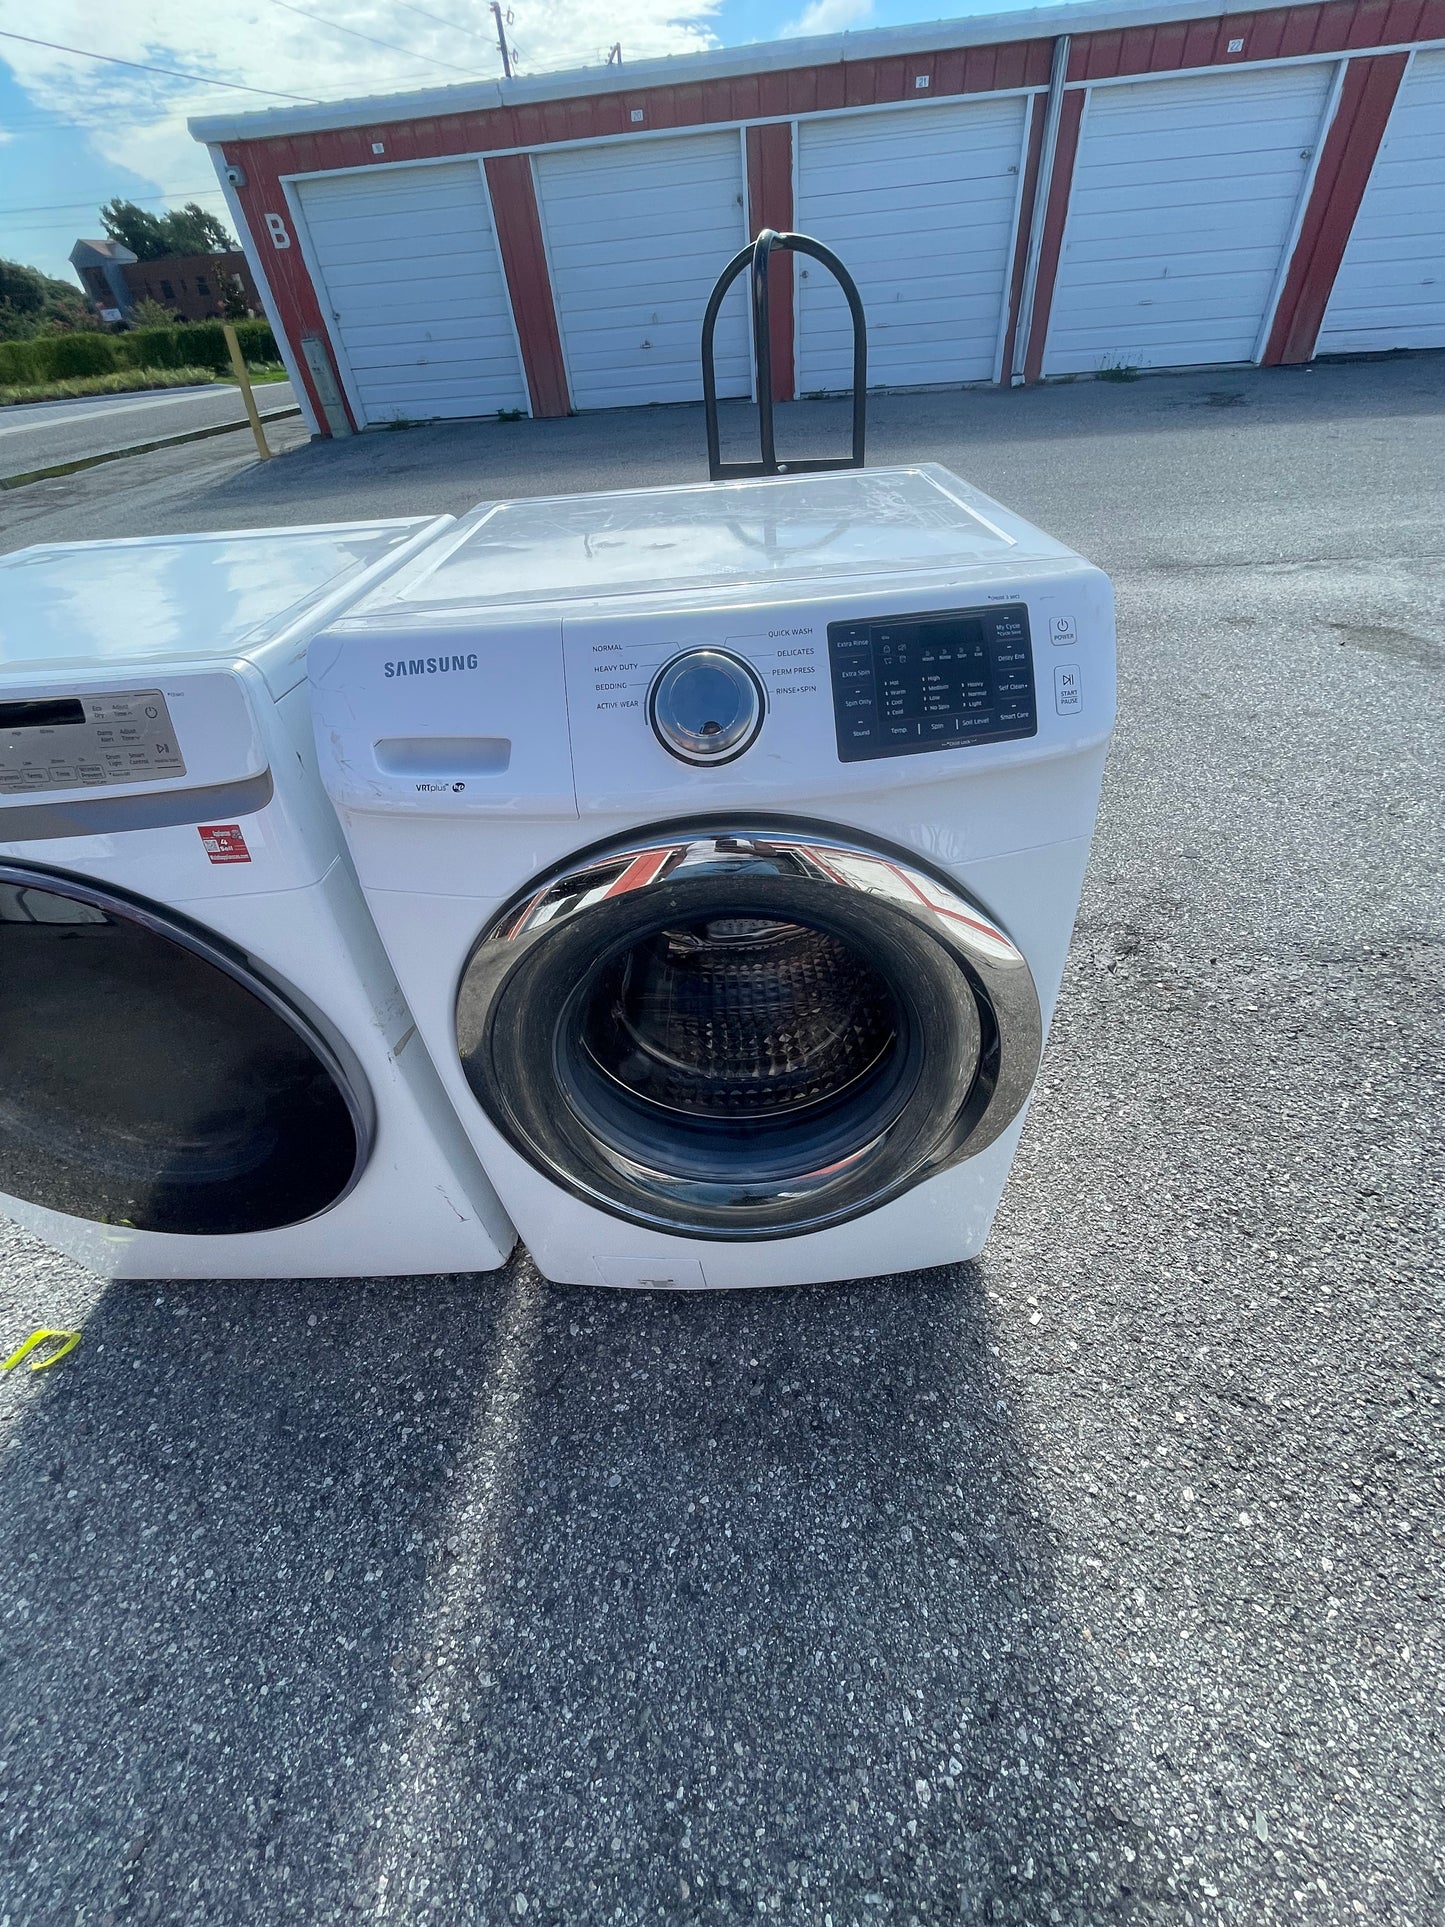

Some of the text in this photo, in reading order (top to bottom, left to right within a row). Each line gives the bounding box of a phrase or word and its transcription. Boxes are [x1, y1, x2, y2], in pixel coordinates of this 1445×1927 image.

[1230, 40, 1242, 50] 22
[264, 213, 291, 249] B
[768, 628, 813, 638] QUICK WASH
[592, 644, 623, 652] NORMAL
[777, 648, 815, 657] DELICATES
[384, 654, 478, 678] SAMSUNG
[594, 664, 618, 672] HEAVY
[772, 668, 792, 676] PERM
[595, 682, 628, 691] BEDDING
